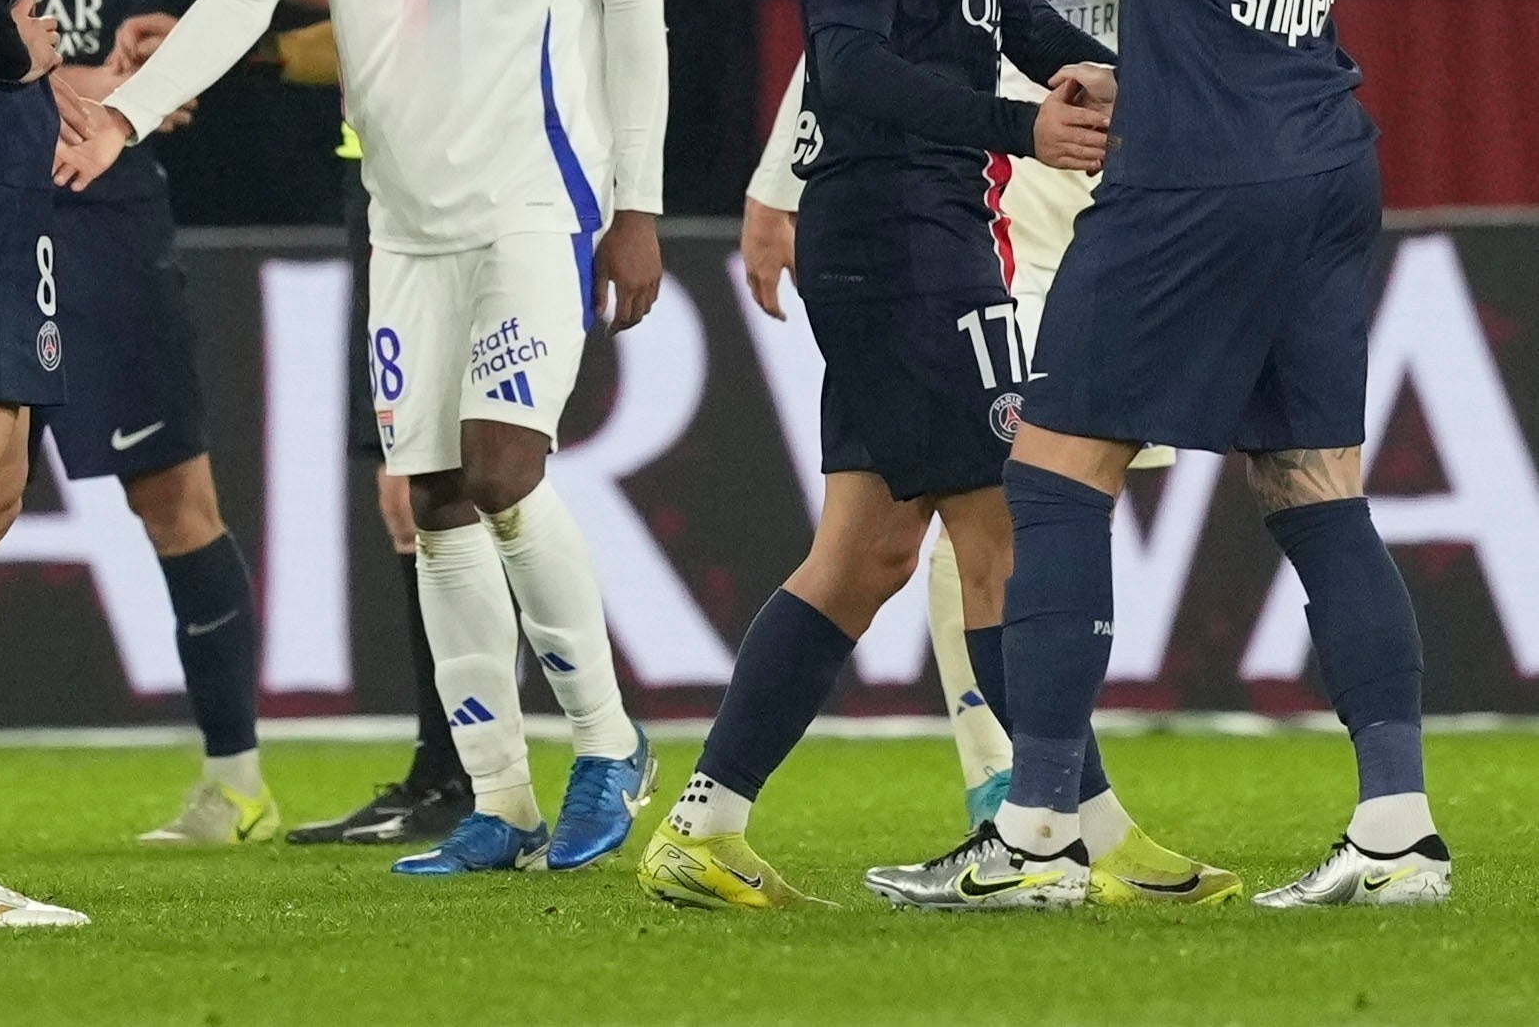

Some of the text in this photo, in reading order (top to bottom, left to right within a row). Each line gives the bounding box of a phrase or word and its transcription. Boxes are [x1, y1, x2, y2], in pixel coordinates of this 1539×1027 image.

[36, 235, 57, 317] 8
[470, 336, 548, 385] match
[471, 317, 520, 364] staff
[957, 302, 1023, 390] 17
